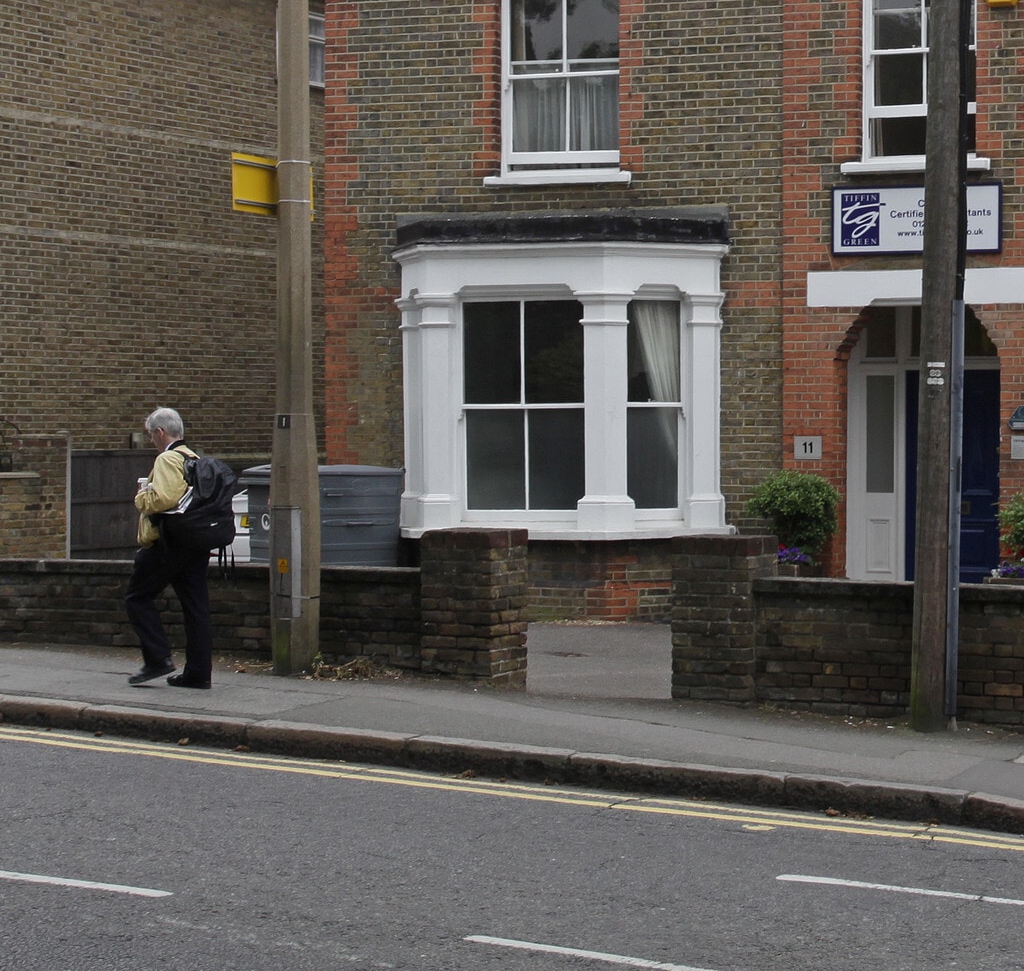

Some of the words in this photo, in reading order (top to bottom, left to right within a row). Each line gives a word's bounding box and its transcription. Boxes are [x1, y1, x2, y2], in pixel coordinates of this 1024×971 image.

[843, 194, 877, 202] TIFFIN
[890, 209, 925, 219] Certifie
[802, 441, 813, 454] 11
